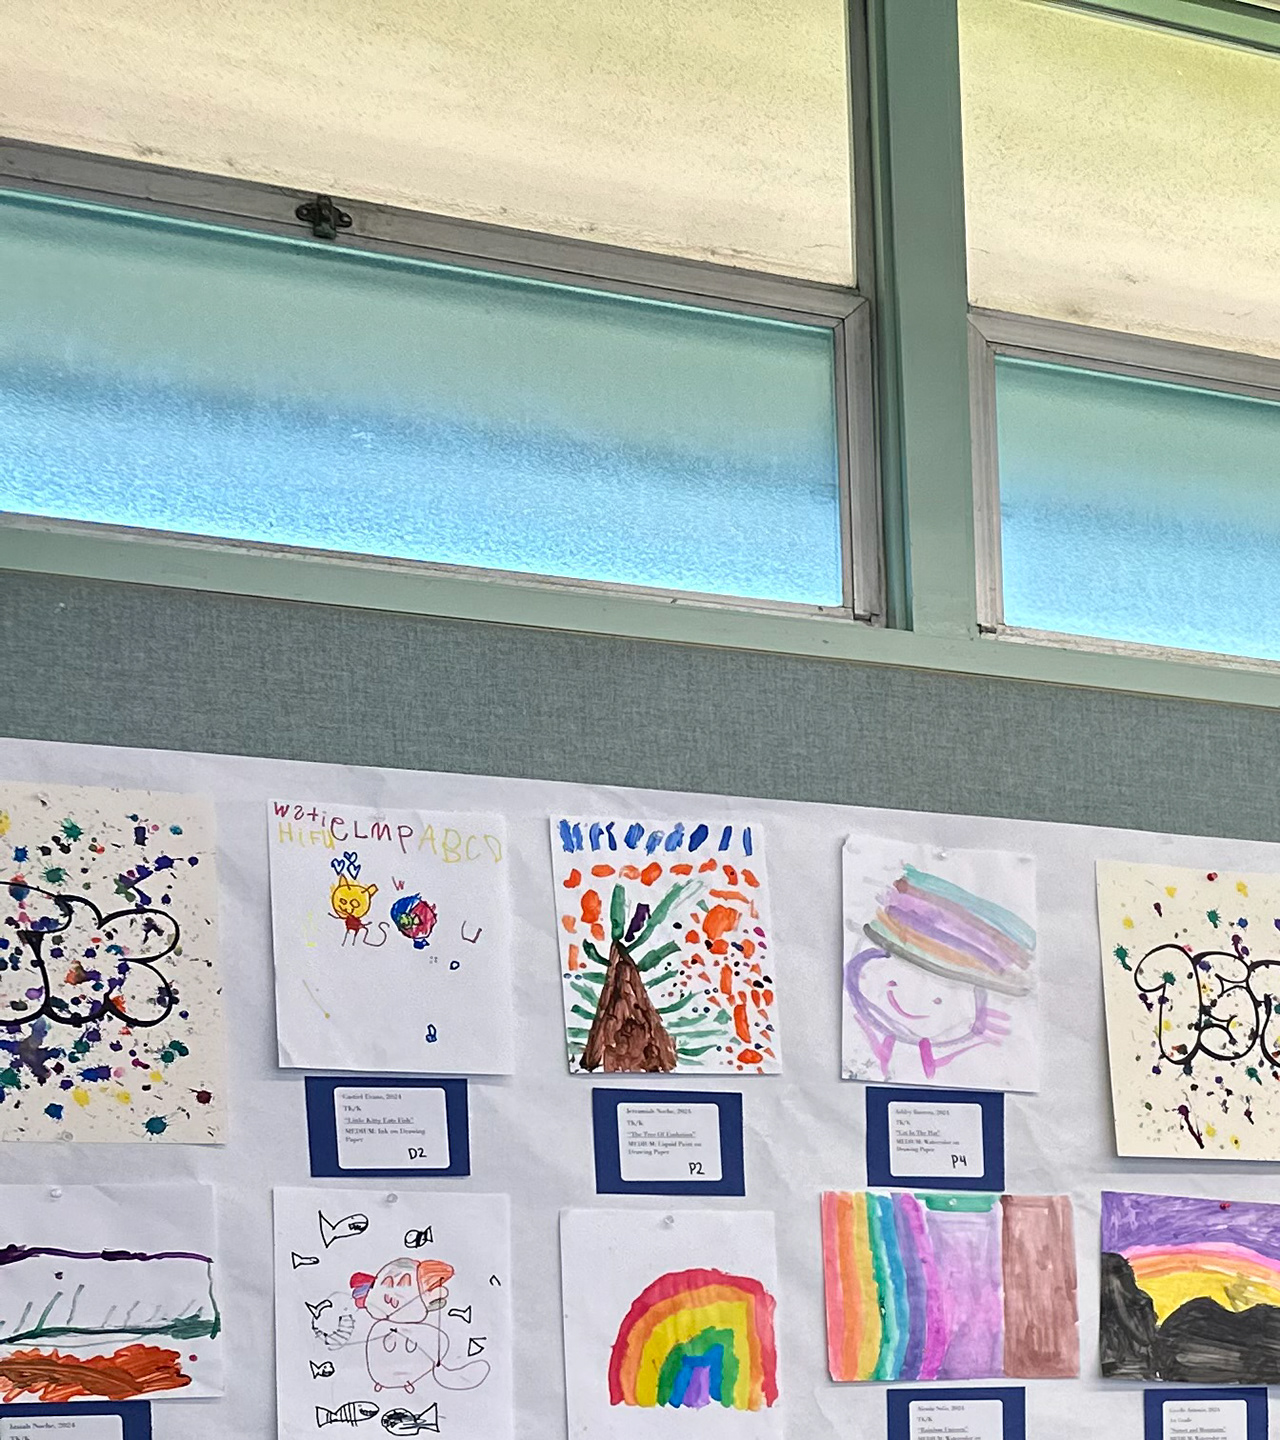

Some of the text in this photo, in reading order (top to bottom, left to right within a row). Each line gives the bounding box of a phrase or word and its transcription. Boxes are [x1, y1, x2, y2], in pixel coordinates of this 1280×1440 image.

[408, 1148, 427, 1159] D2
[951, 1155, 967, 1168] P4
[689, 1162, 705, 1175] P2
